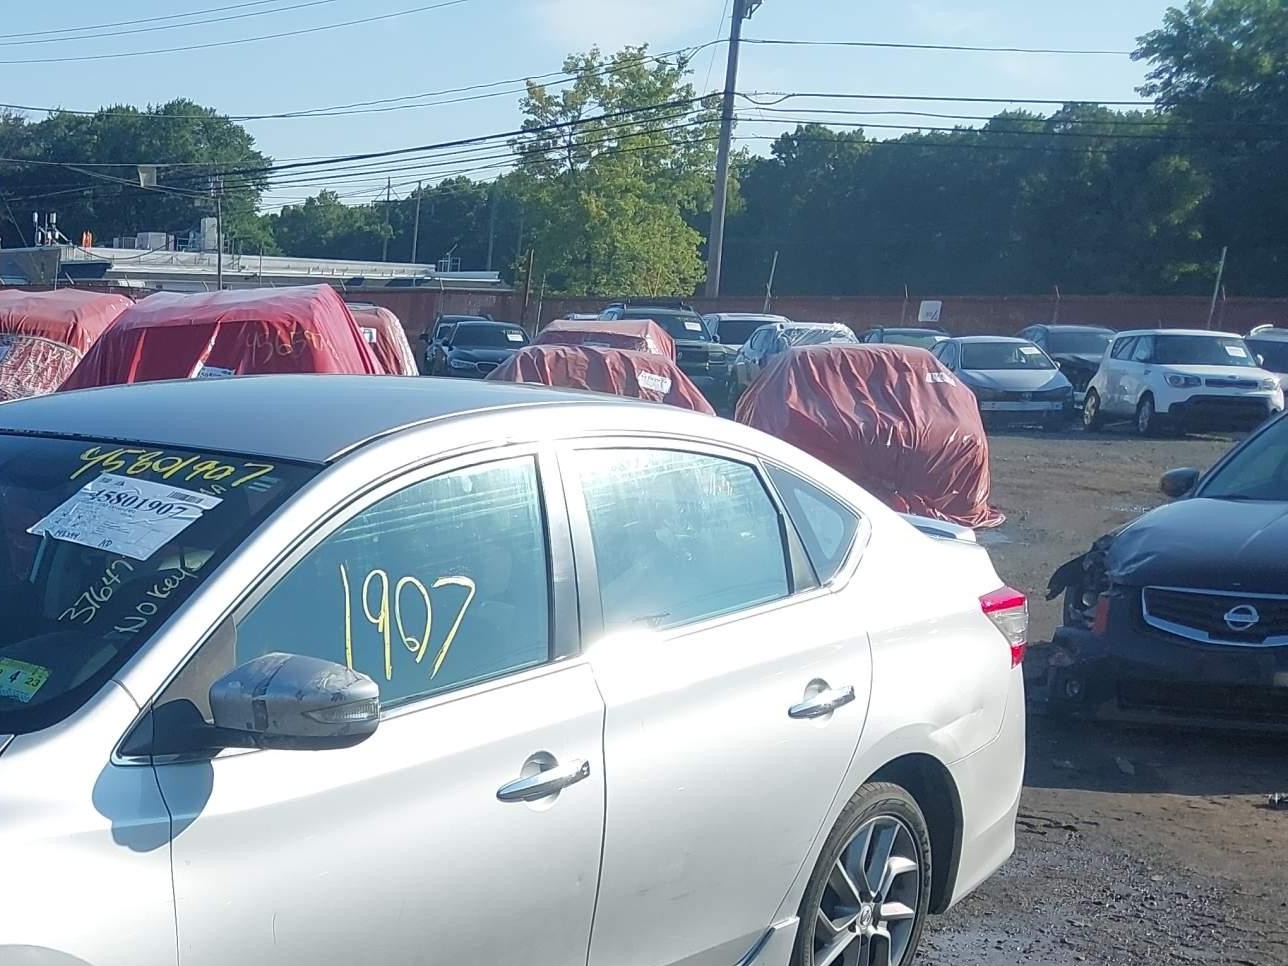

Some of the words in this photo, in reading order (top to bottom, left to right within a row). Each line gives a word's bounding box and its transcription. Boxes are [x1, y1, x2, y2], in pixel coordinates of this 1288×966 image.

[70, 446, 275, 487] 45801907
[339, 562, 476, 681] 1907
[9, 670, 22, 682] 4
